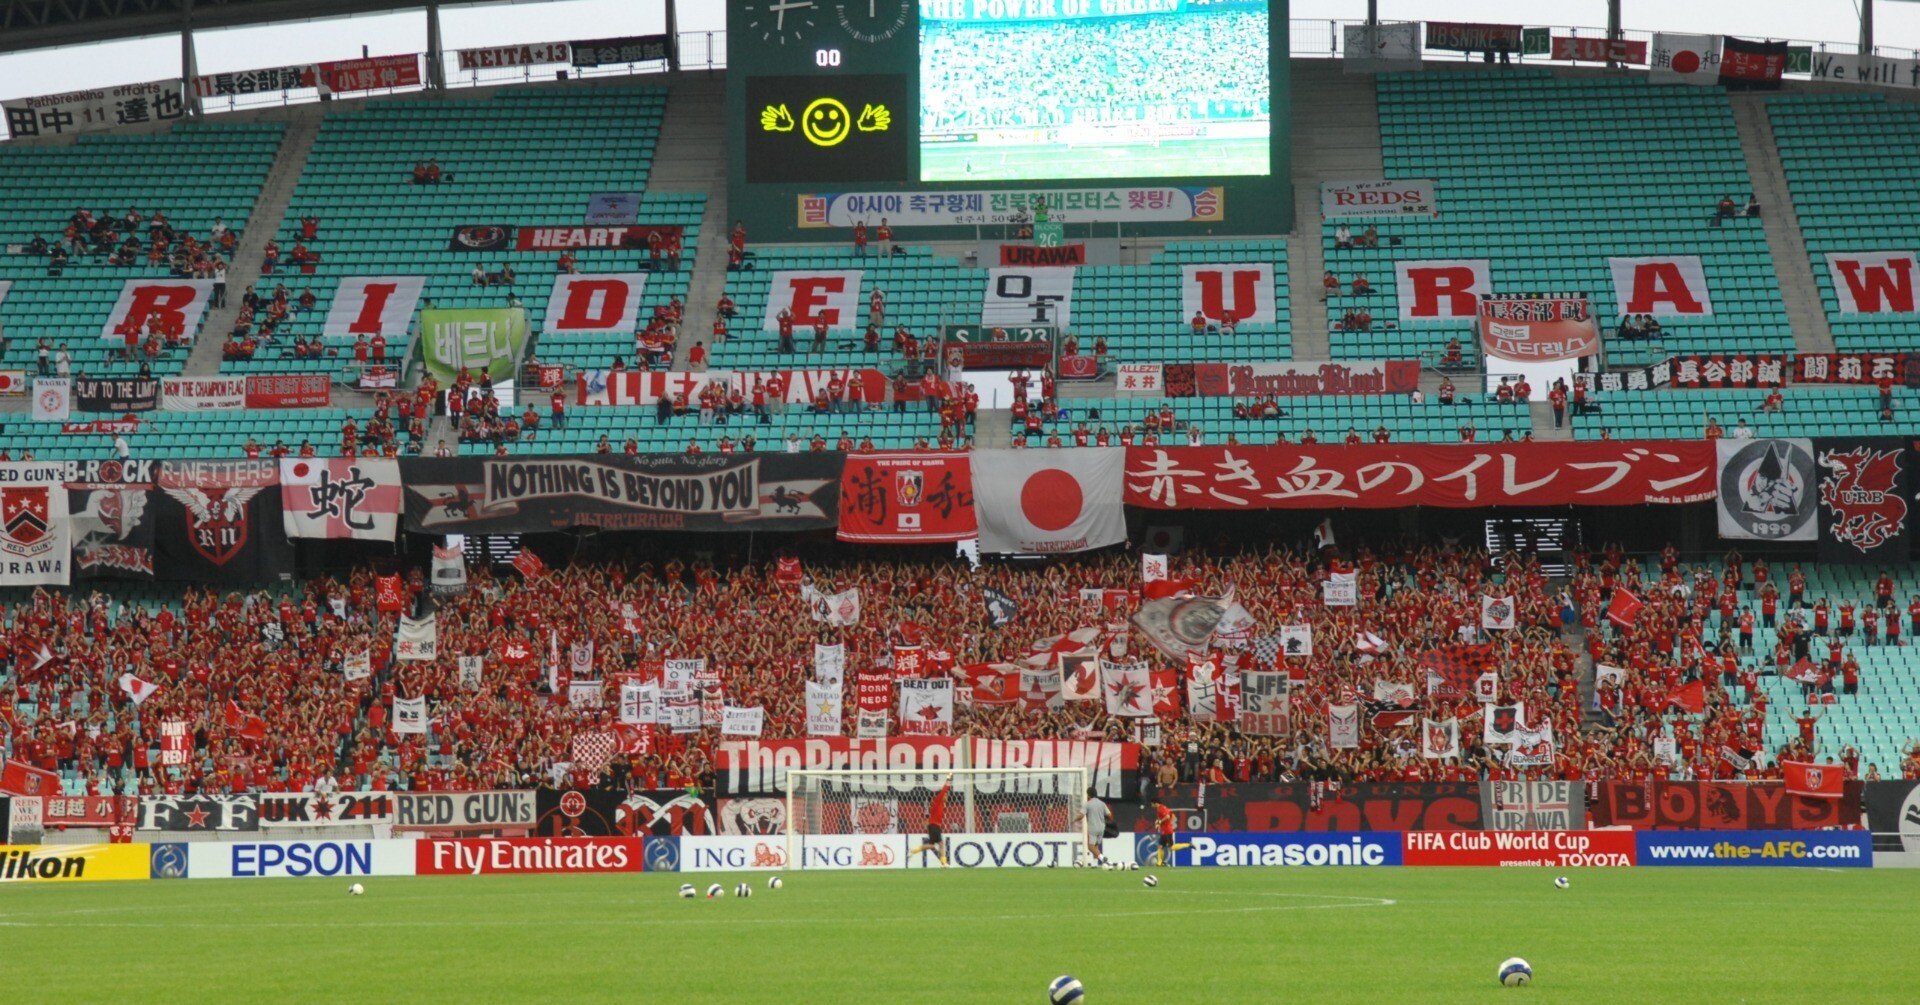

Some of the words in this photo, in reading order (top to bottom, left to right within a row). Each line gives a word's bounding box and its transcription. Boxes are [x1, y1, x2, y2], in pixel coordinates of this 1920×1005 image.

[920, 0, 965, 19] THE
[972, 0, 1053, 18] POWER
[1062, 0, 1093, 16] OF
[461, 46, 533, 68] KEITA
[547, 43, 568, 62] 13
[574, 43, 665, 65] 長谷部誠
[816, 49, 840, 66] 00
[339, 66, 419, 90] 小野伸二
[1813, 55, 1845, 79] We
[1857, 63, 1897, 84] will
[192, 76, 213, 97] 11
[215, 67, 304, 95] 長谷部誠
[26, 89, 105, 110] Pathbreaking
[113, 82, 161, 98] efforts
[5, 107, 74, 138] 田中
[83, 107, 105, 123] 11
[115, 88, 184, 126] 達也
[846, 194, 903, 214] 아시아
[909, 193, 983, 213] 축구황제
[1194, 191, 1217, 217] 승
[1335, 190, 1422, 206] REDS
[803, 197, 826, 224] 필
[531, 227, 628, 248] HEART
[1039, 232, 1058, 248] 2G
[1006, 246, 1079, 265] URAWA
[113, 284, 197, 336] R
[557, 280, 629, 330] D
[789, 277, 846, 326] E
[1195, 270, 1261, 322] U
[1407, 266, 1477, 317] R
[1626, 262, 1704, 314] A
[1834, 257, 1915, 313] W
[1490, 324, 1526, 339] 그랜드
[1677, 359, 1782, 384] 長谷部誠
[77, 381, 98, 398] PLAY
[102, 381, 114, 398] TO
[117, 381, 133, 398] THE
[136, 381, 157, 398] LIMIT
[163, 380, 181, 397] SHOW
[182, 381, 194, 397] THE
[195, 380, 226, 398] CHAMPION
[227, 379, 244, 395] FLAG
[257, 379, 274, 394] THE
[161, 460, 275, 483] R-NETTERS
[633, 455, 651, 465] No
[681, 456, 698, 465] No
[698, 456, 728, 468] glory
[24, 467, 65, 481] GUN's
[1124, 447, 1709, 507] 赤き血のイレブン
[490, 463, 595, 501] NOTHING
[598, 466, 621, 500] IS
[623, 472, 705, 511] BEYOND
[708, 465, 753, 510] YOU
[841, 466, 889, 526] 浦
[1644, 494, 1670, 504] Made
[1672, 495, 1682, 504] in
[1684, 490, 1718, 503] URAWA
[307, 467, 376, 530] 蛇
[1842, 491, 1885, 504] URB
[1752, 522, 1792, 535] 1999
[6, 542, 25, 553] RED
[666, 661, 701, 670] COME
[858, 673, 891, 682] NATURAL
[903, 679, 928, 690] BEAT
[931, 680, 950, 690] OUT
[1241, 674, 1288, 695] LIFE
[860, 684, 888, 693] BORN
[860, 696, 888, 704] REDS
[1241, 695, 1262, 713] IS
[161, 721, 188, 735] PAINT
[1241, 713, 1288, 735] RED
[171, 735, 182, 750] IT
[162, 751, 188, 765] RED!
[718, 742, 802, 795] The
[803, 738, 916, 796] Pride
[975, 737, 1122, 799] URAWA
[48, 799, 86, 817] 超越
[138, 800, 180, 831] F
[215, 800, 258, 831] F
[264, 796, 309, 823] UK
[338, 794, 387, 820] 211
[401, 795, 454, 825] RED
[464, 792, 531, 824] GUN's
[1494, 812, 1567, 831] URAWA
[1190, 836, 1385, 867] Panasonic
[1407, 832, 1446, 850] FIFA
[1450, 832, 1492, 850] Club
[1495, 832, 1550, 850] World
[1554, 832, 1590, 854] Cup
[1650, 841, 1861, 859] www.the-AFC.com
[231, 842, 372, 877] EPSON
[433, 841, 486, 875] Fly
[490, 839, 629, 873] Emirates
[695, 847, 746, 868] ING
[802, 847, 853, 866] ING
[1500, 859, 1542, 867] presented
[1544, 859, 1556, 867] by
[1558, 853, 1631, 867] TOYOTA
